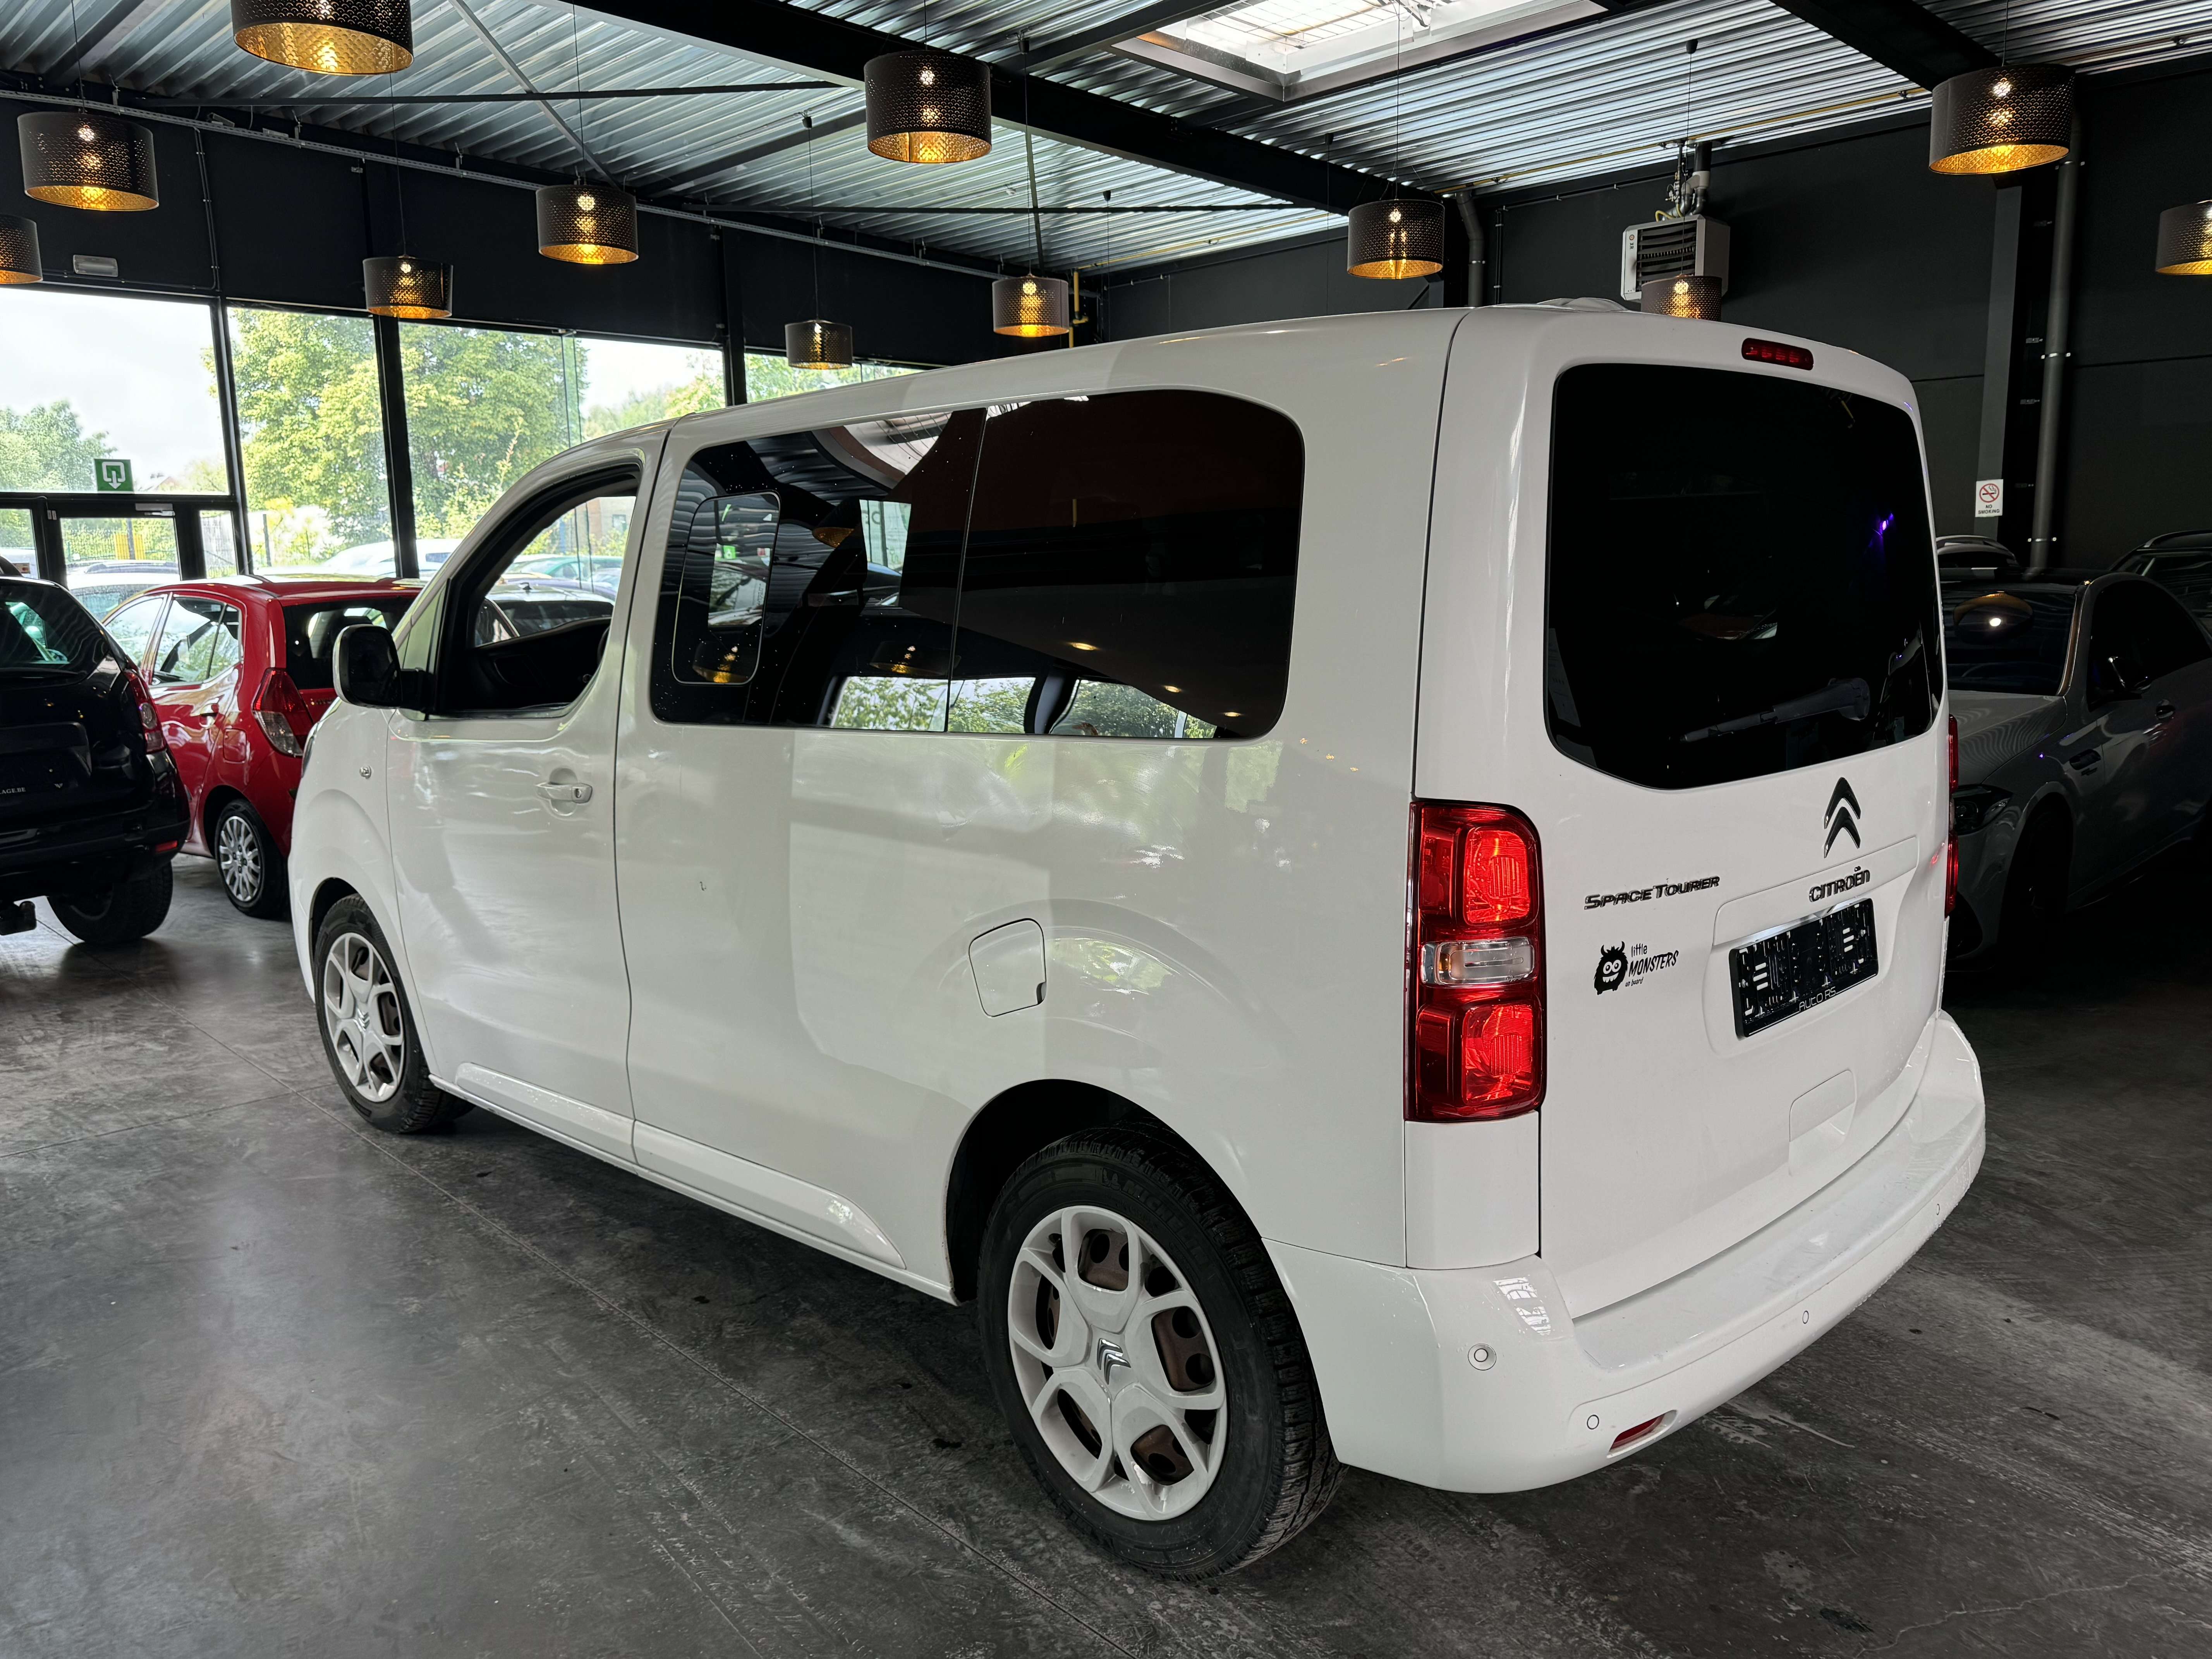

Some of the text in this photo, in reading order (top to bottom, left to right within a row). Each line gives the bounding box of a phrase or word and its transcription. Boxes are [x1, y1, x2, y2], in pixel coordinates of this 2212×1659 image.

[1809, 866, 1870, 902] CITROËN
[1631, 943, 1647, 957] little
[1629, 950, 1679, 977] MONSTERS
[1824, 986, 1836, 1000] RS
